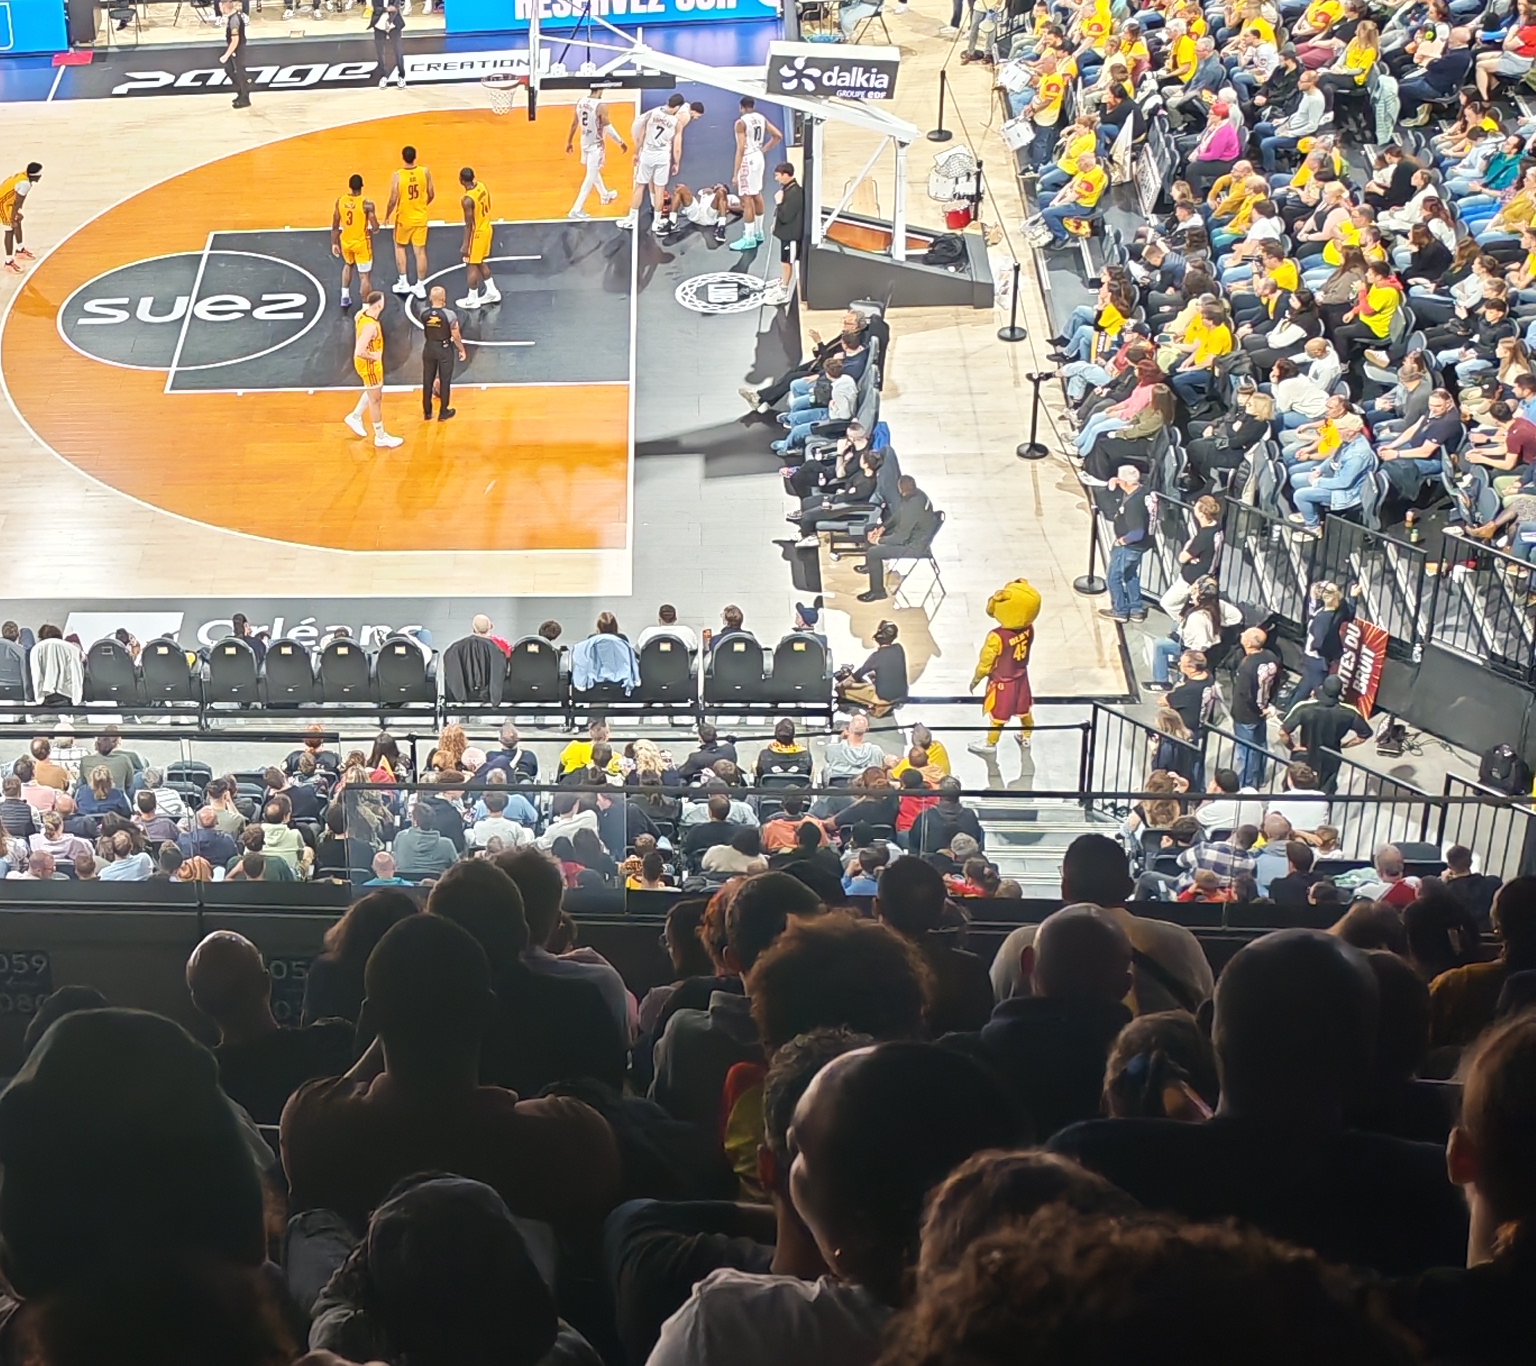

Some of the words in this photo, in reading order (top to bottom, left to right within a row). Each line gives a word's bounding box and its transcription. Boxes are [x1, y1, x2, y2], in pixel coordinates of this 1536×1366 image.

[409, 58, 531, 73] CREATION
[822, 66, 890, 90] dalkia
[582, 111, 590, 127] 2
[656, 124, 665, 140] 7
[408, 183, 420, 200] 95
[346, 209, 354, 226] 3
[77, 292, 309, 325] suez
[1344, 623, 1361, 650] DU
[1013, 642, 1028, 663] 45
[1353, 644, 1376, 695] BRUIT
